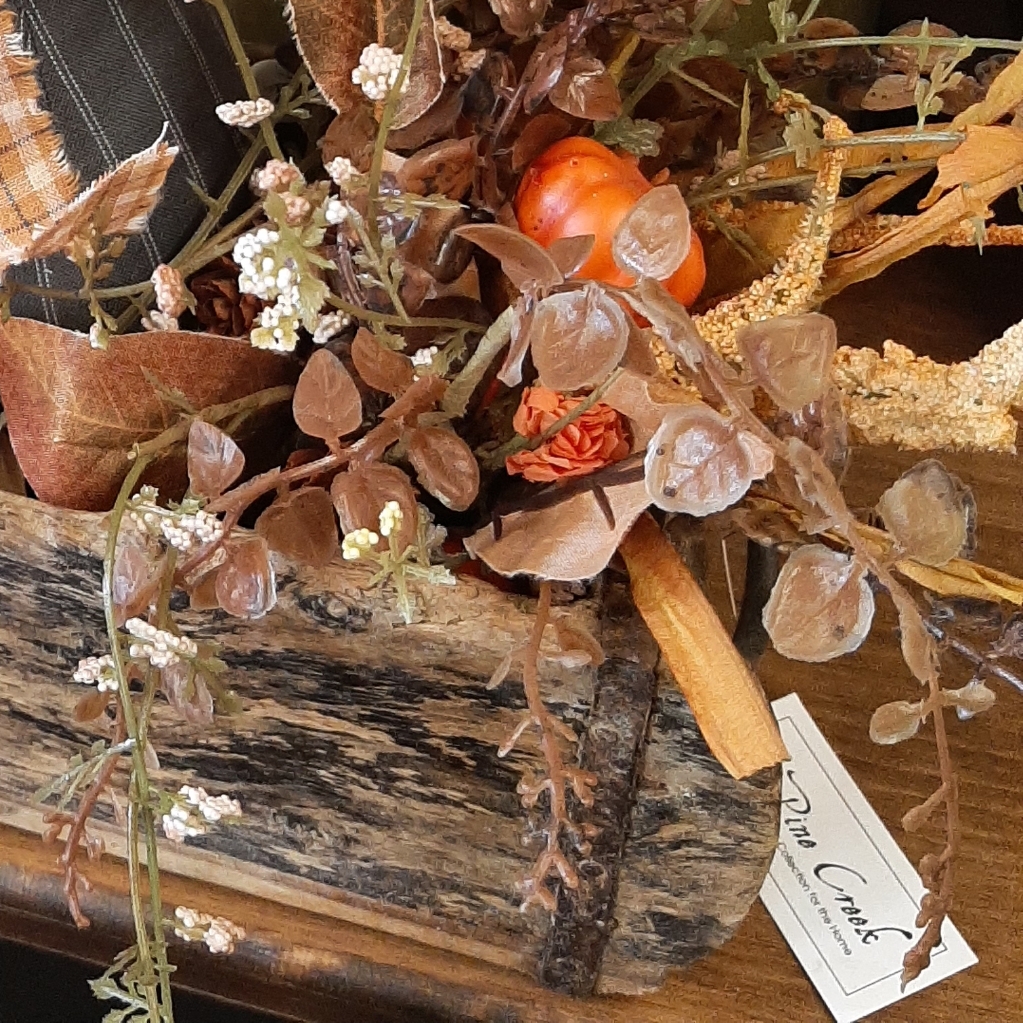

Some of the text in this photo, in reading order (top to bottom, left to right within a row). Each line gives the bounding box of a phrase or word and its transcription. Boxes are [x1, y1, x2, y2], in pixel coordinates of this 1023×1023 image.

[809, 892, 821, 906] for
[817, 907, 832, 925] the
[828, 924, 852, 956] Home
[813, 863, 913, 944] Creek
